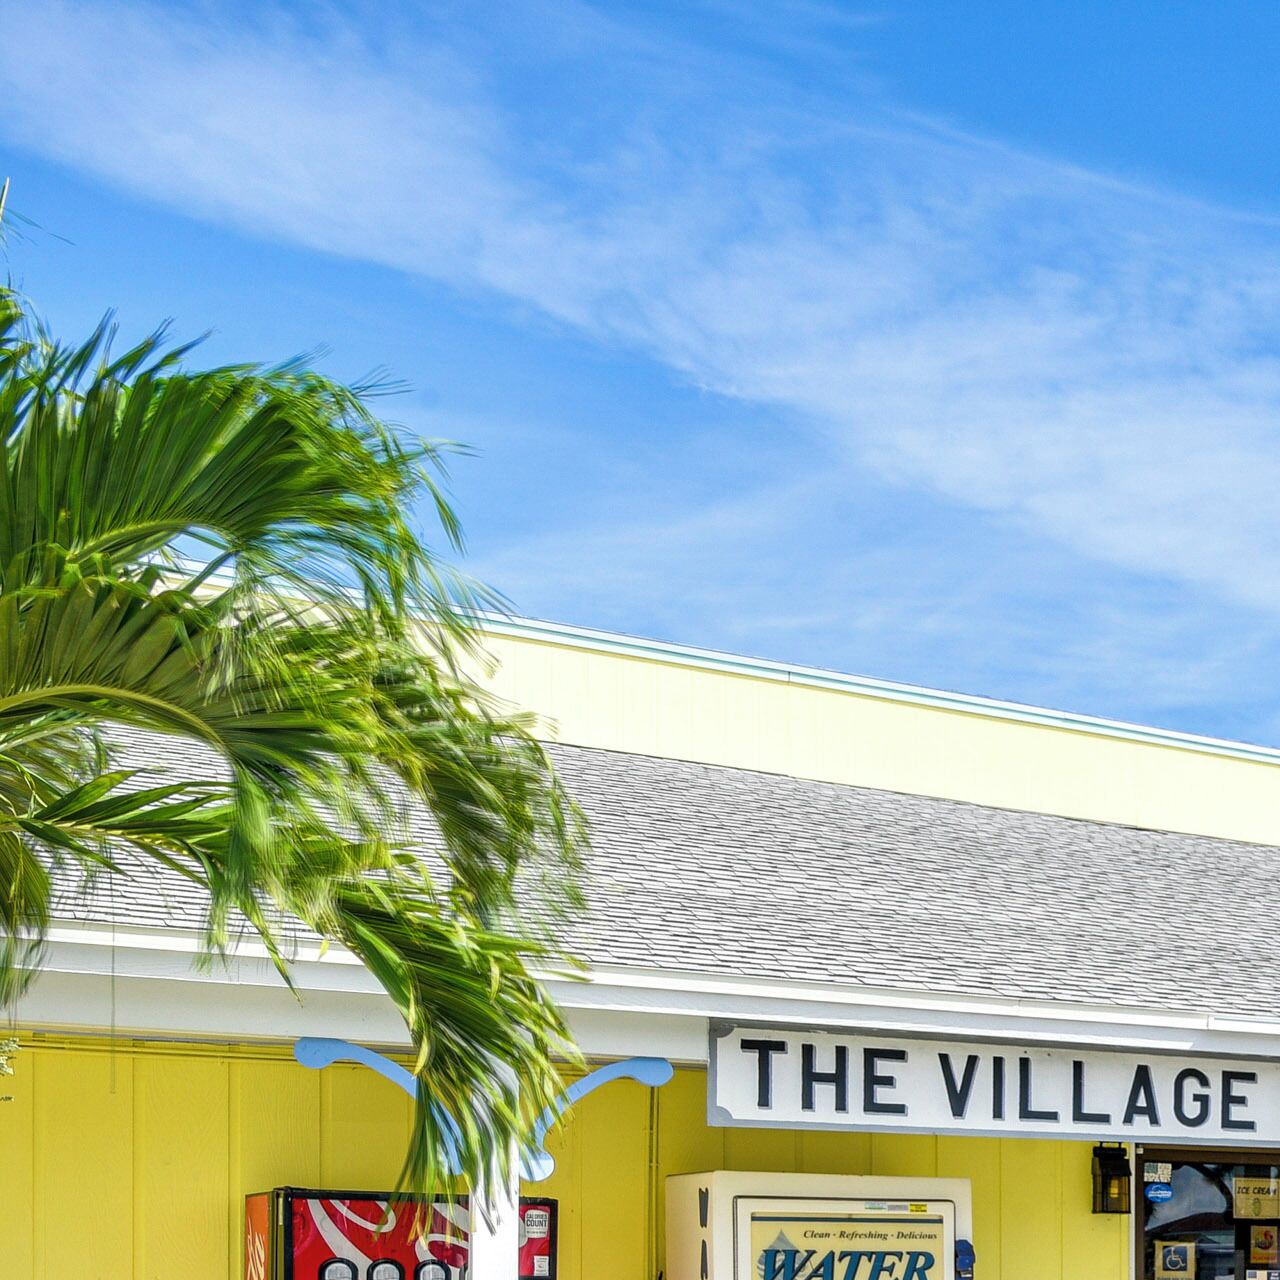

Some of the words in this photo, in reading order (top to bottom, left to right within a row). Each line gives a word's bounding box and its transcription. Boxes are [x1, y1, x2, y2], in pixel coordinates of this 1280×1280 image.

[740, 1038, 907, 1116] THE
[938, 1052, 1257, 1132] VILLAGE
[1237, 1186, 1250, 1195] ICE
[526, 1219, 547, 1227] COUNT
[803, 1230, 831, 1239] Clean
[839, 1230, 888, 1241] Refreshing
[896, 1231, 937, 1240] Delicious
